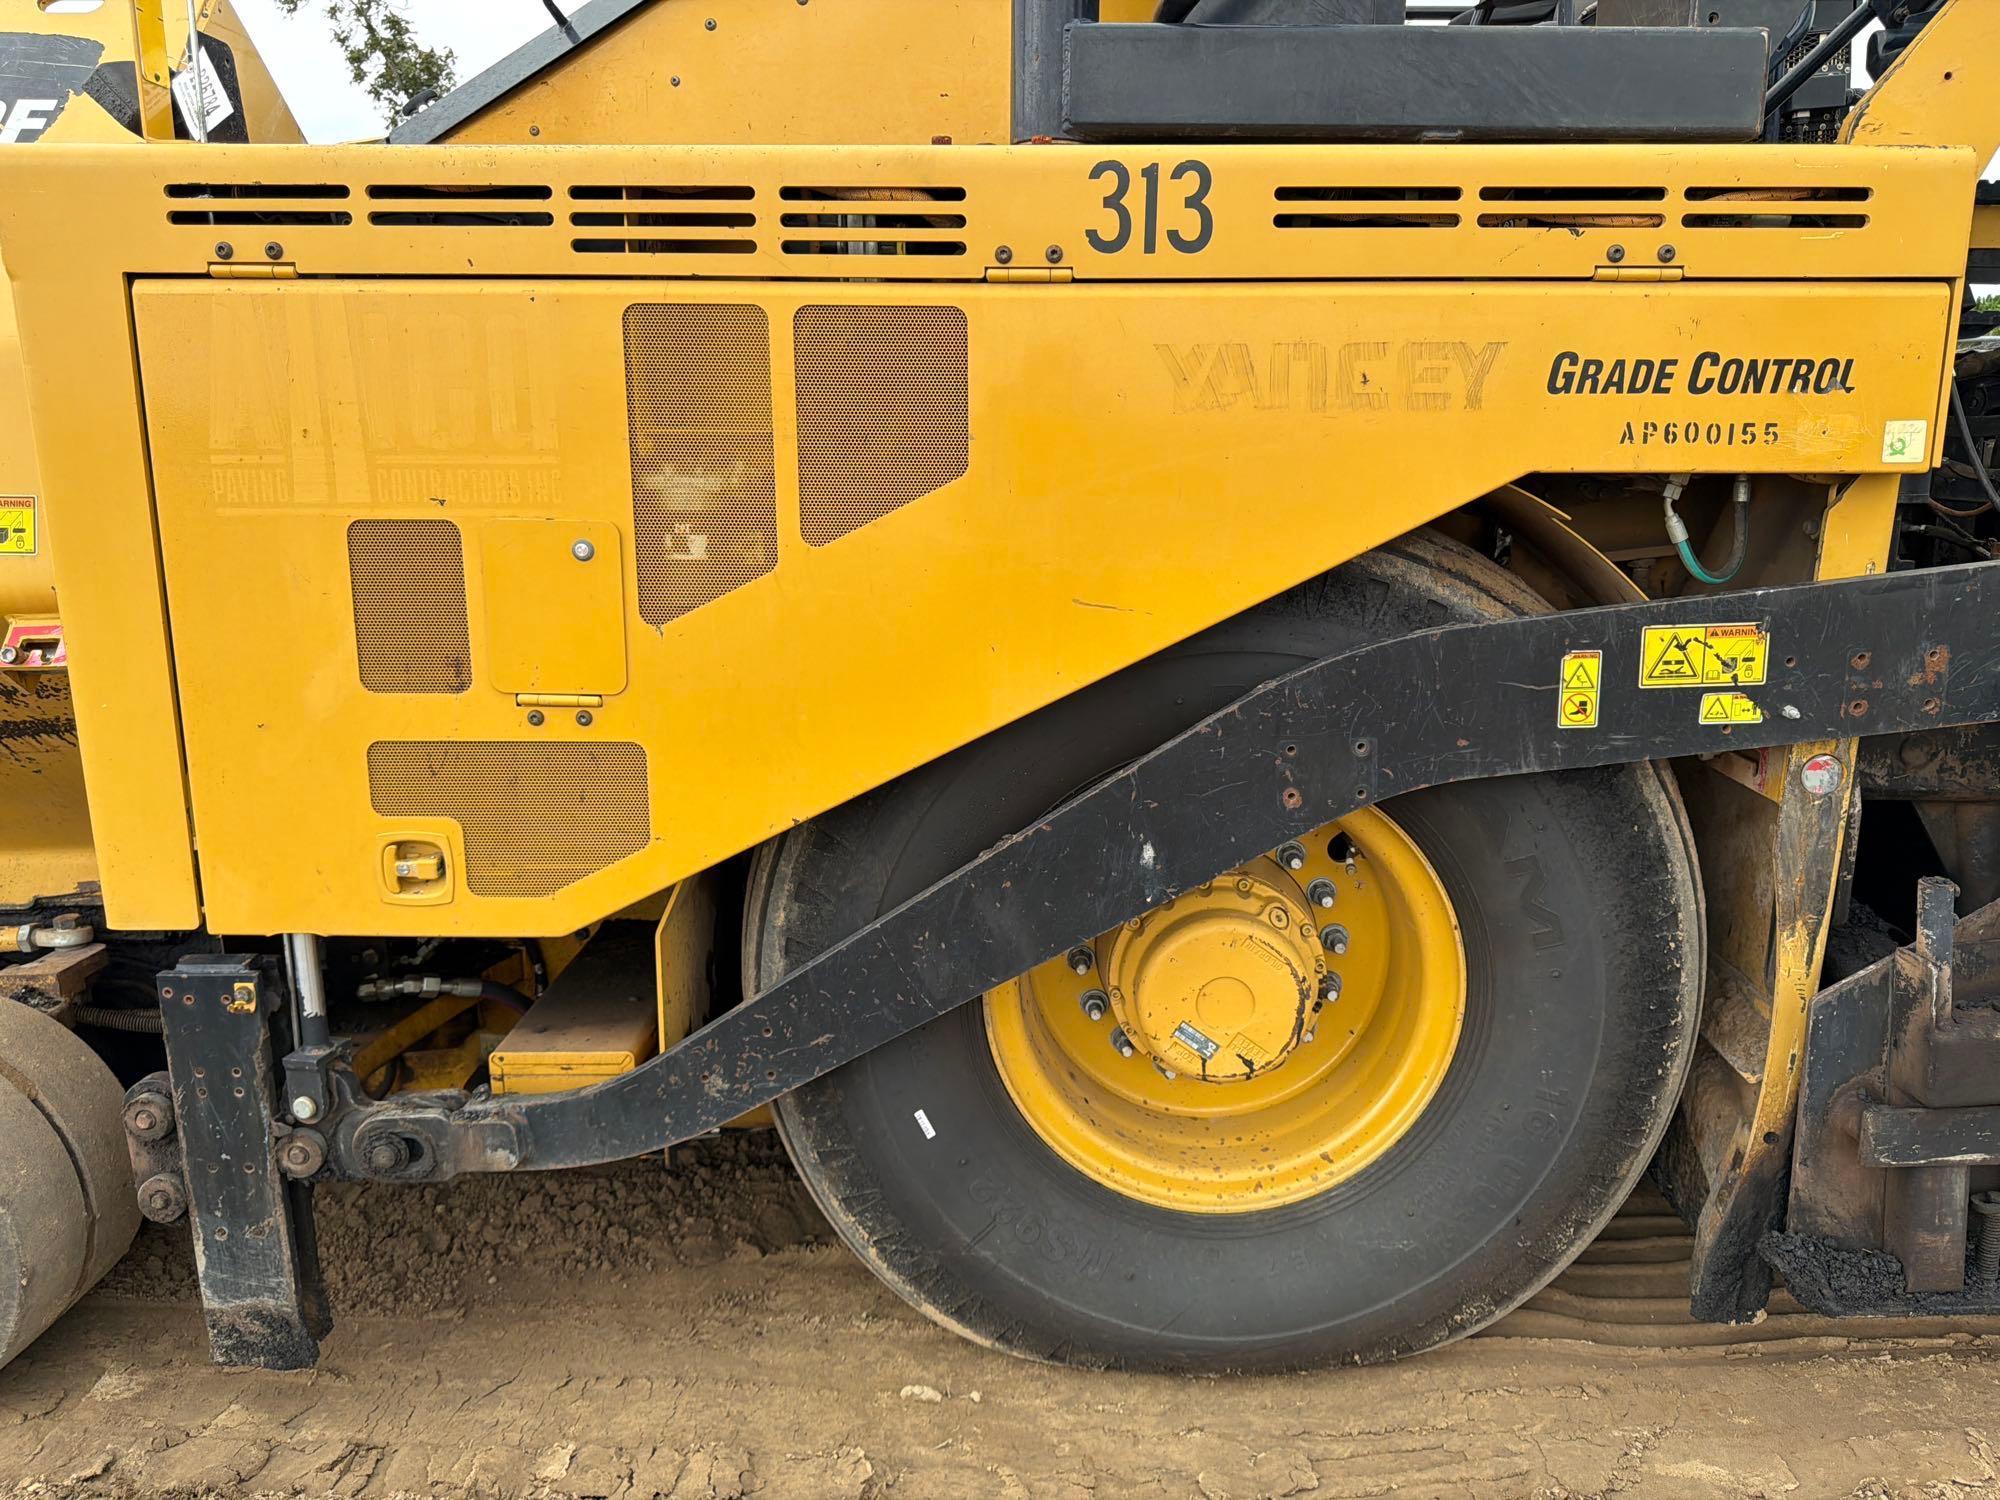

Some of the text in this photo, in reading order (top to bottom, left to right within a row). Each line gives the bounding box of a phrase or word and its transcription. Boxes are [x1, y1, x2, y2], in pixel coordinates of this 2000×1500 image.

[0, 99, 58, 143] F
[1085, 160, 1213, 254] 313
[1546, 351, 1856, 395] GRADE CONTROL
[1620, 421, 1780, 446] AP600155
[0, 500, 32, 508] ARNING
[212, 468, 289, 503] PAVING
[376, 468, 521, 504] CONTRACTORS
[1721, 627, 1758, 637] WARNIN
